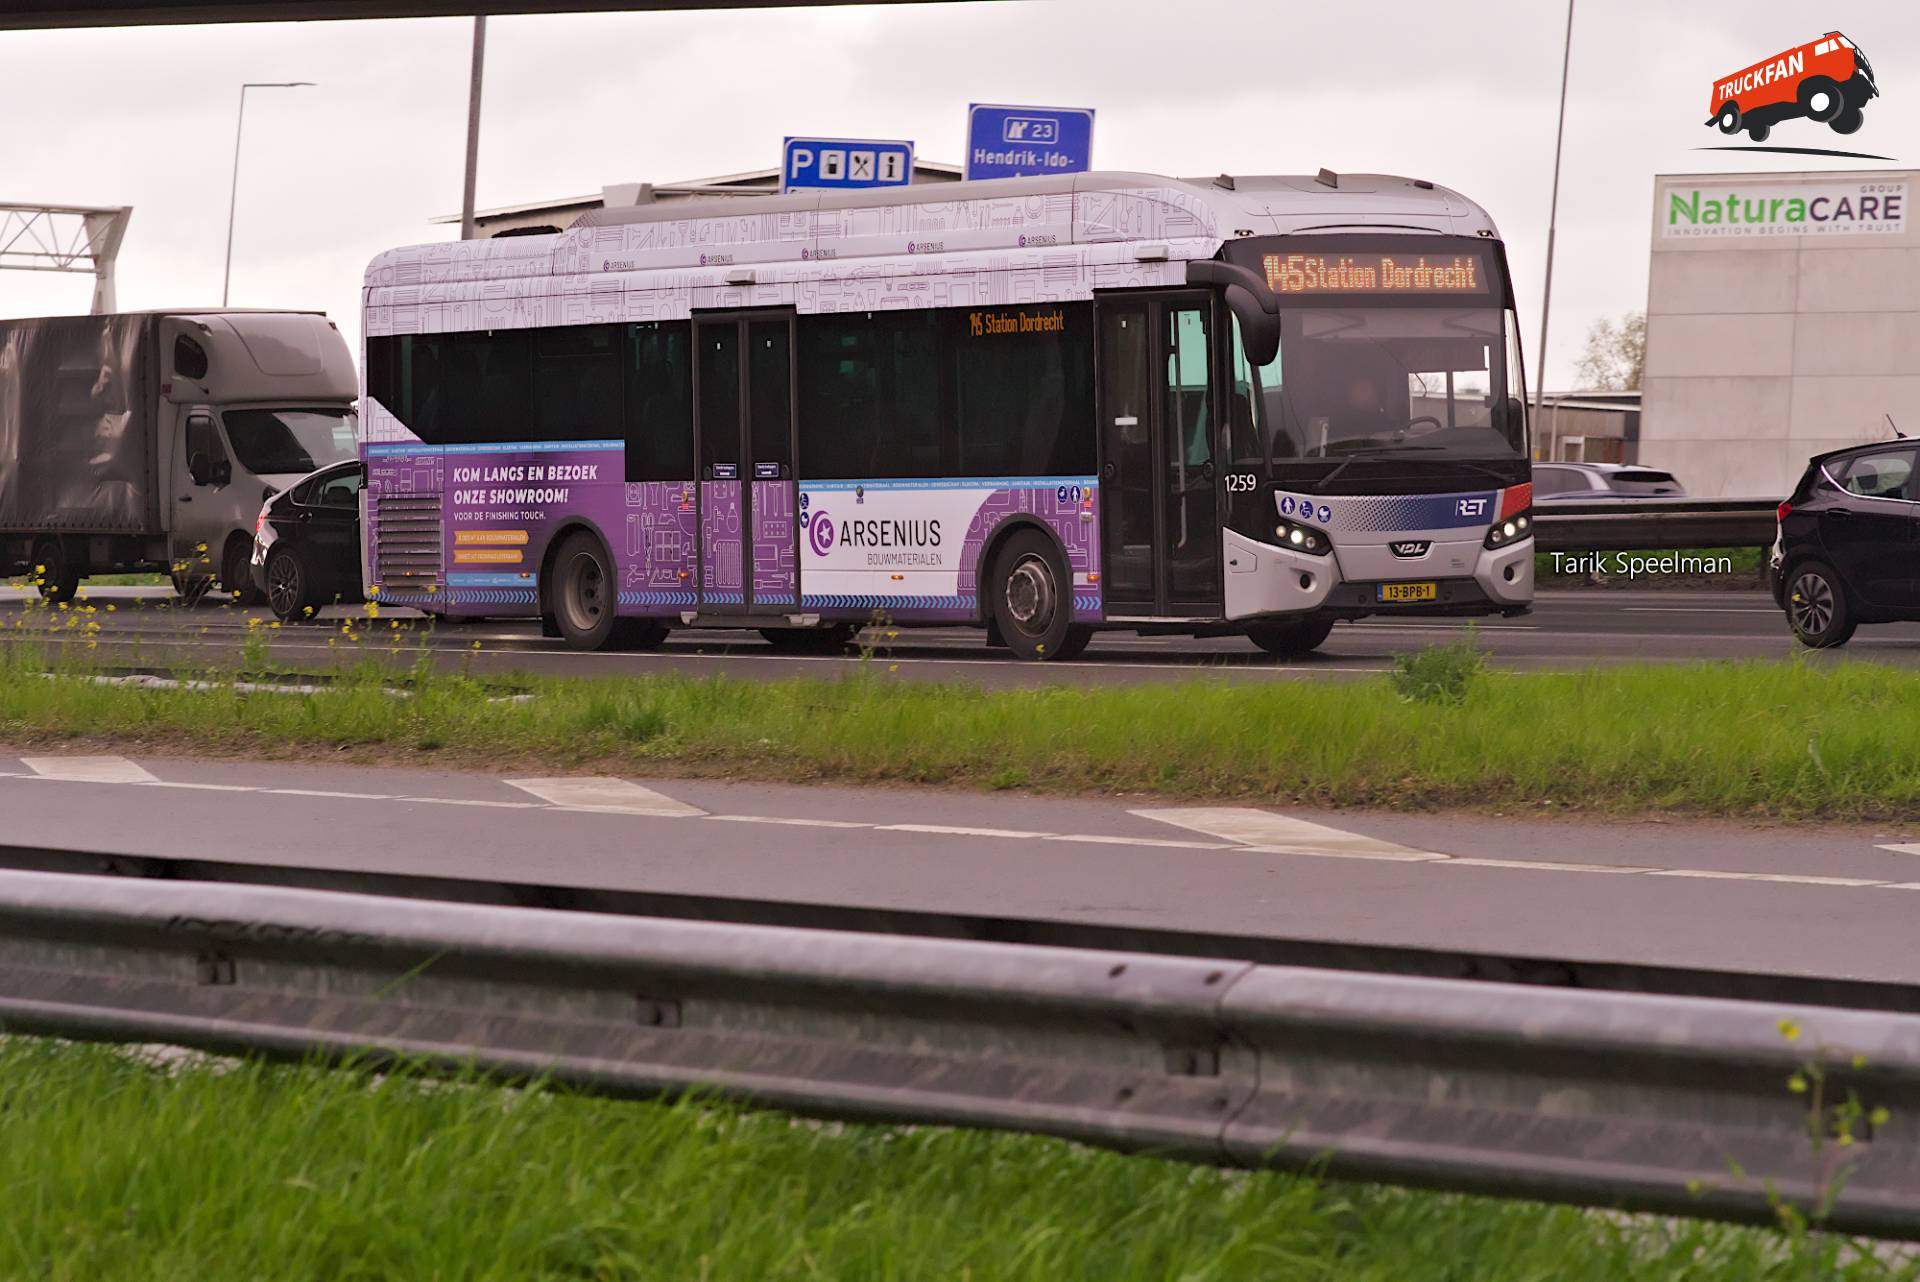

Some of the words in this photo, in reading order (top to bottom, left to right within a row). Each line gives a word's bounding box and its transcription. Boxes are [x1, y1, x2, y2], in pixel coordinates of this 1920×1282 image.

[1032, 124, 1053, 138] 23
[974, 148, 1075, 167] Hendrik-Ido-
[1860, 184, 1903, 193] GROUP
[1669, 190, 1902, 225] NaturaCARE
[1667, 226, 1752, 236] INNOVATION
[1759, 225, 1809, 235] BEGINS
[1817, 224, 1850, 233] WITH
[1859, 223, 1900, 232] TRUST
[916, 241, 944, 251] ARSENIUS
[1026, 234, 1056, 244] ARSENIUS
[707, 254, 733, 263] ARSENIUS
[809, 248, 836, 257] ARSENIUS
[610, 261, 635, 269] ARSENIUS
[1305, 258, 1376, 288] Station
[1381, 257, 1477, 288] Dordrecht
[985, 312, 1018, 334] Station
[1020, 310, 1064, 332] Dordrecht
[453, 467, 480, 482] KOM
[484, 466, 524, 482] LANGS
[528, 466, 544, 481] EN
[548, 465, 598, 480] BEZOEK
[1224, 474, 1257, 491] 1259
[453, 489, 486, 505] ONZE
[490, 488, 568, 504] SHOWROOM!
[1455, 499, 1487, 516] RET
[454, 512, 473, 521] VOOR
[474, 512, 484, 521] DE
[485, 511, 519, 520] FINISHING
[520, 511, 546, 520] TOUCH.
[840, 519, 941, 547] ARSENIUS
[1394, 543, 1426, 554] VDL
[867, 552, 942, 566] BOUWMATERIALEN
[1389, 585, 1430, 598] 13-BPB-1
